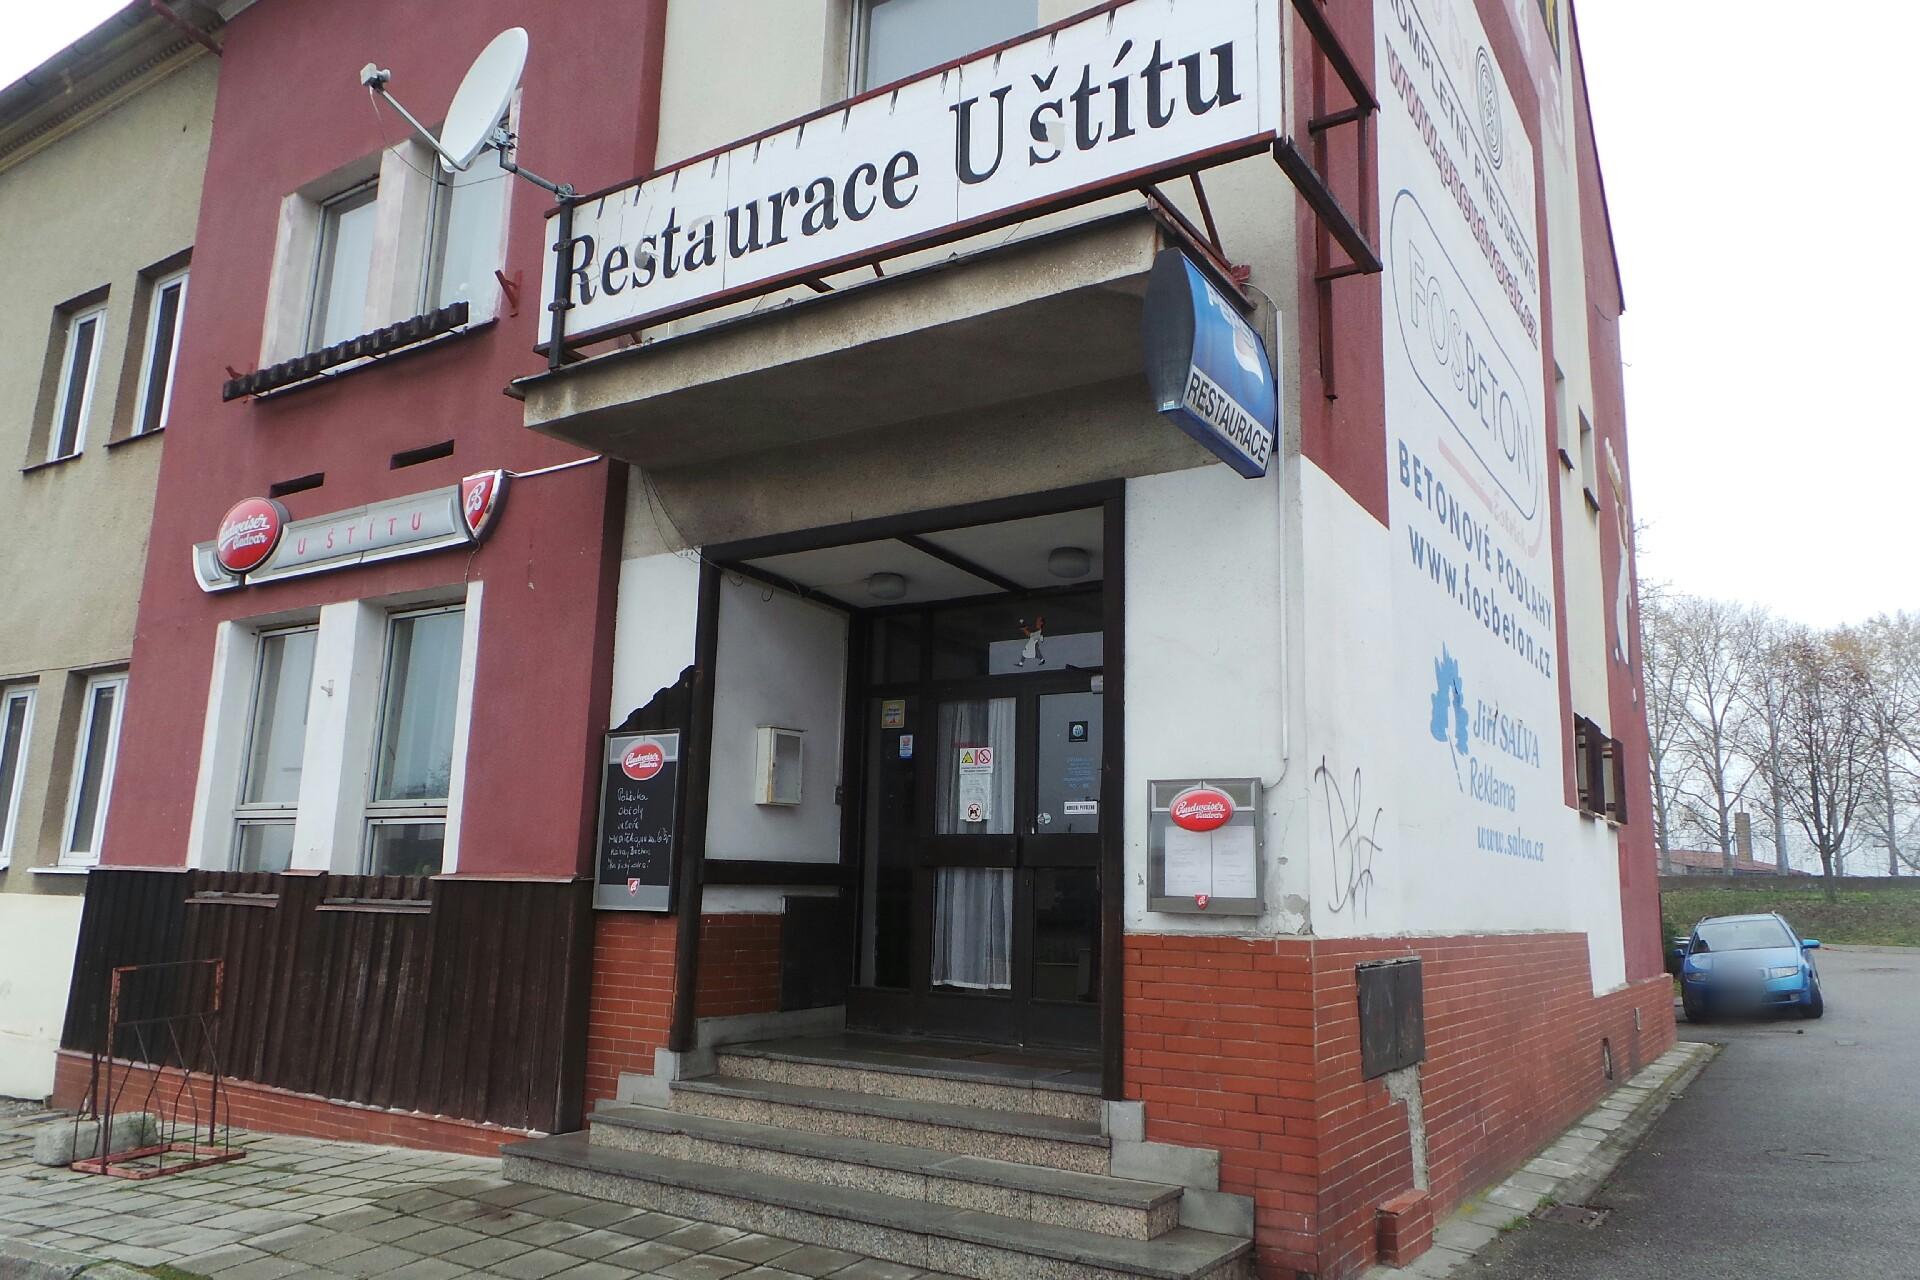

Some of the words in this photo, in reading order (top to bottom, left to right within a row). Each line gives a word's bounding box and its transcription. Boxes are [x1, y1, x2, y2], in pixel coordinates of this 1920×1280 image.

[1391, 0, 1468, 158] OMPLETNÍ
[569, 150, 920, 306] Restaurace
[949, 84, 1013, 185] U
[1029, 38, 1243, 167] štítu
[1187, 372, 1270, 464] RESTAURACE
[297, 537, 306, 555] U
[326, 511, 423, 548] ŠTÍTU
[1398, 438, 1492, 572] BETONOVÉ
[1498, 547, 1552, 632] PODLAHY
[1175, 800, 1226, 818] Budweiser
[1469, 756, 1516, 812] Reklama
